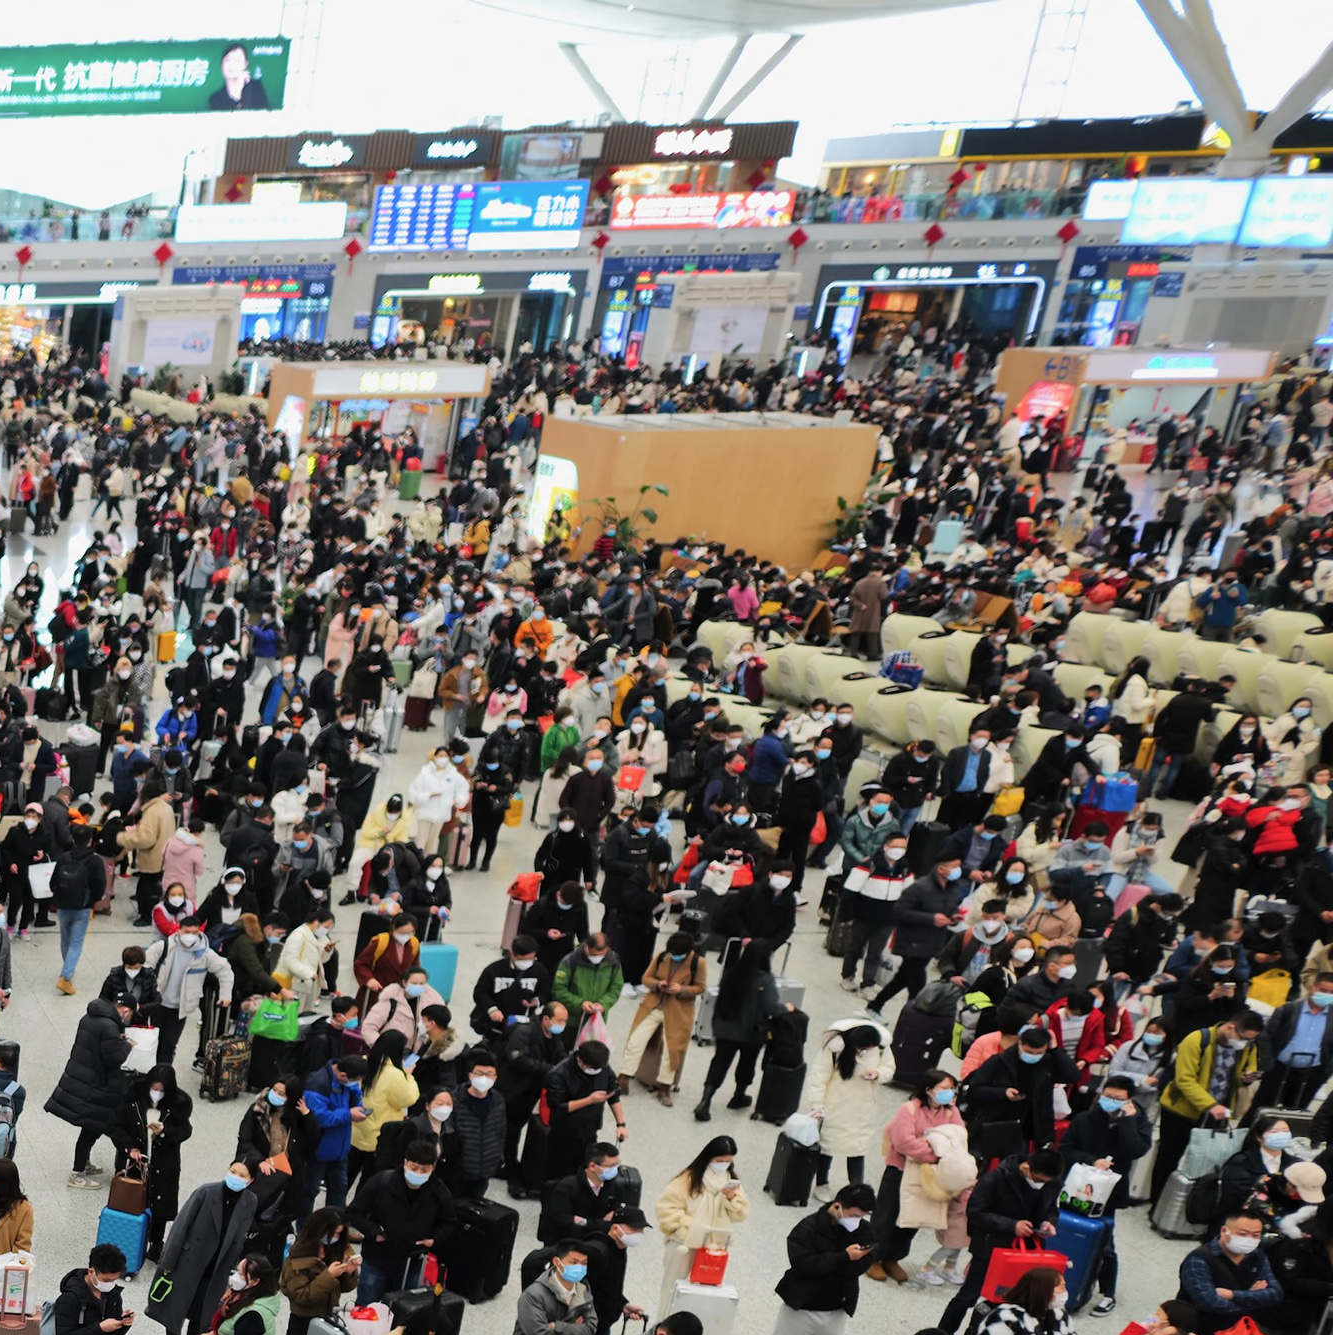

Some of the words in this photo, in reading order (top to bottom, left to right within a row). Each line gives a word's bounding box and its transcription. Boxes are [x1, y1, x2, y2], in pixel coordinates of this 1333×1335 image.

[63, 57, 209, 92] 抗菌健康厨房
